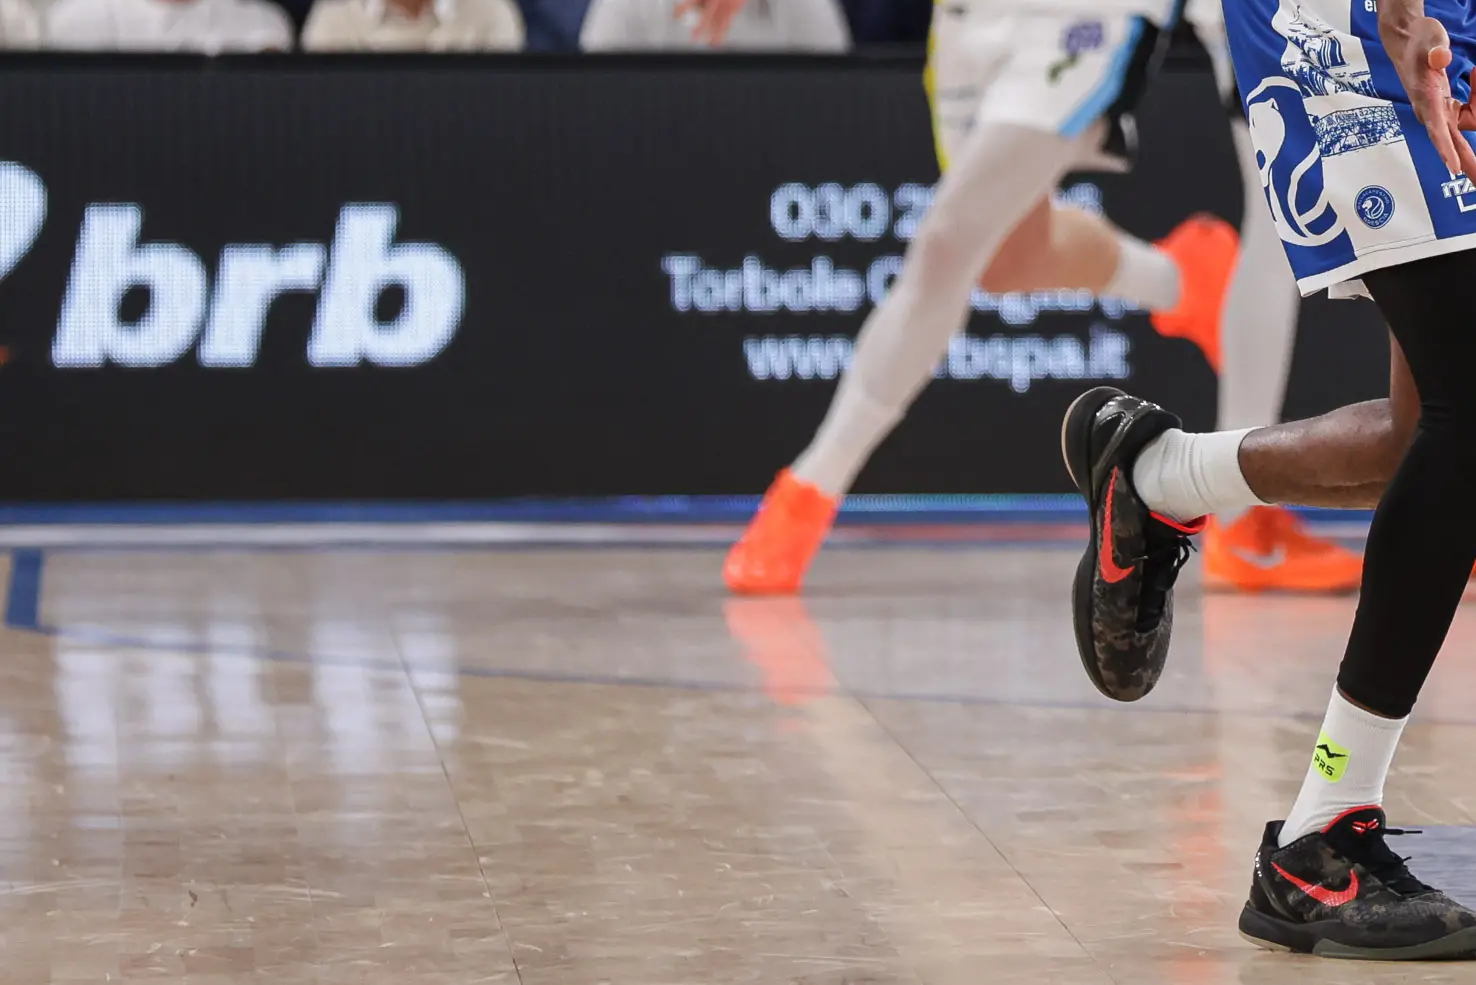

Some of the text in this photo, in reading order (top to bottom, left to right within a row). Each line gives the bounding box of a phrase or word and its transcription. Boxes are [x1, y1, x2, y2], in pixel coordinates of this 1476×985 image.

[771, 183, 888, 241] 030
[52, 203, 465, 367] brb
[661, 255, 865, 311] Torbole
